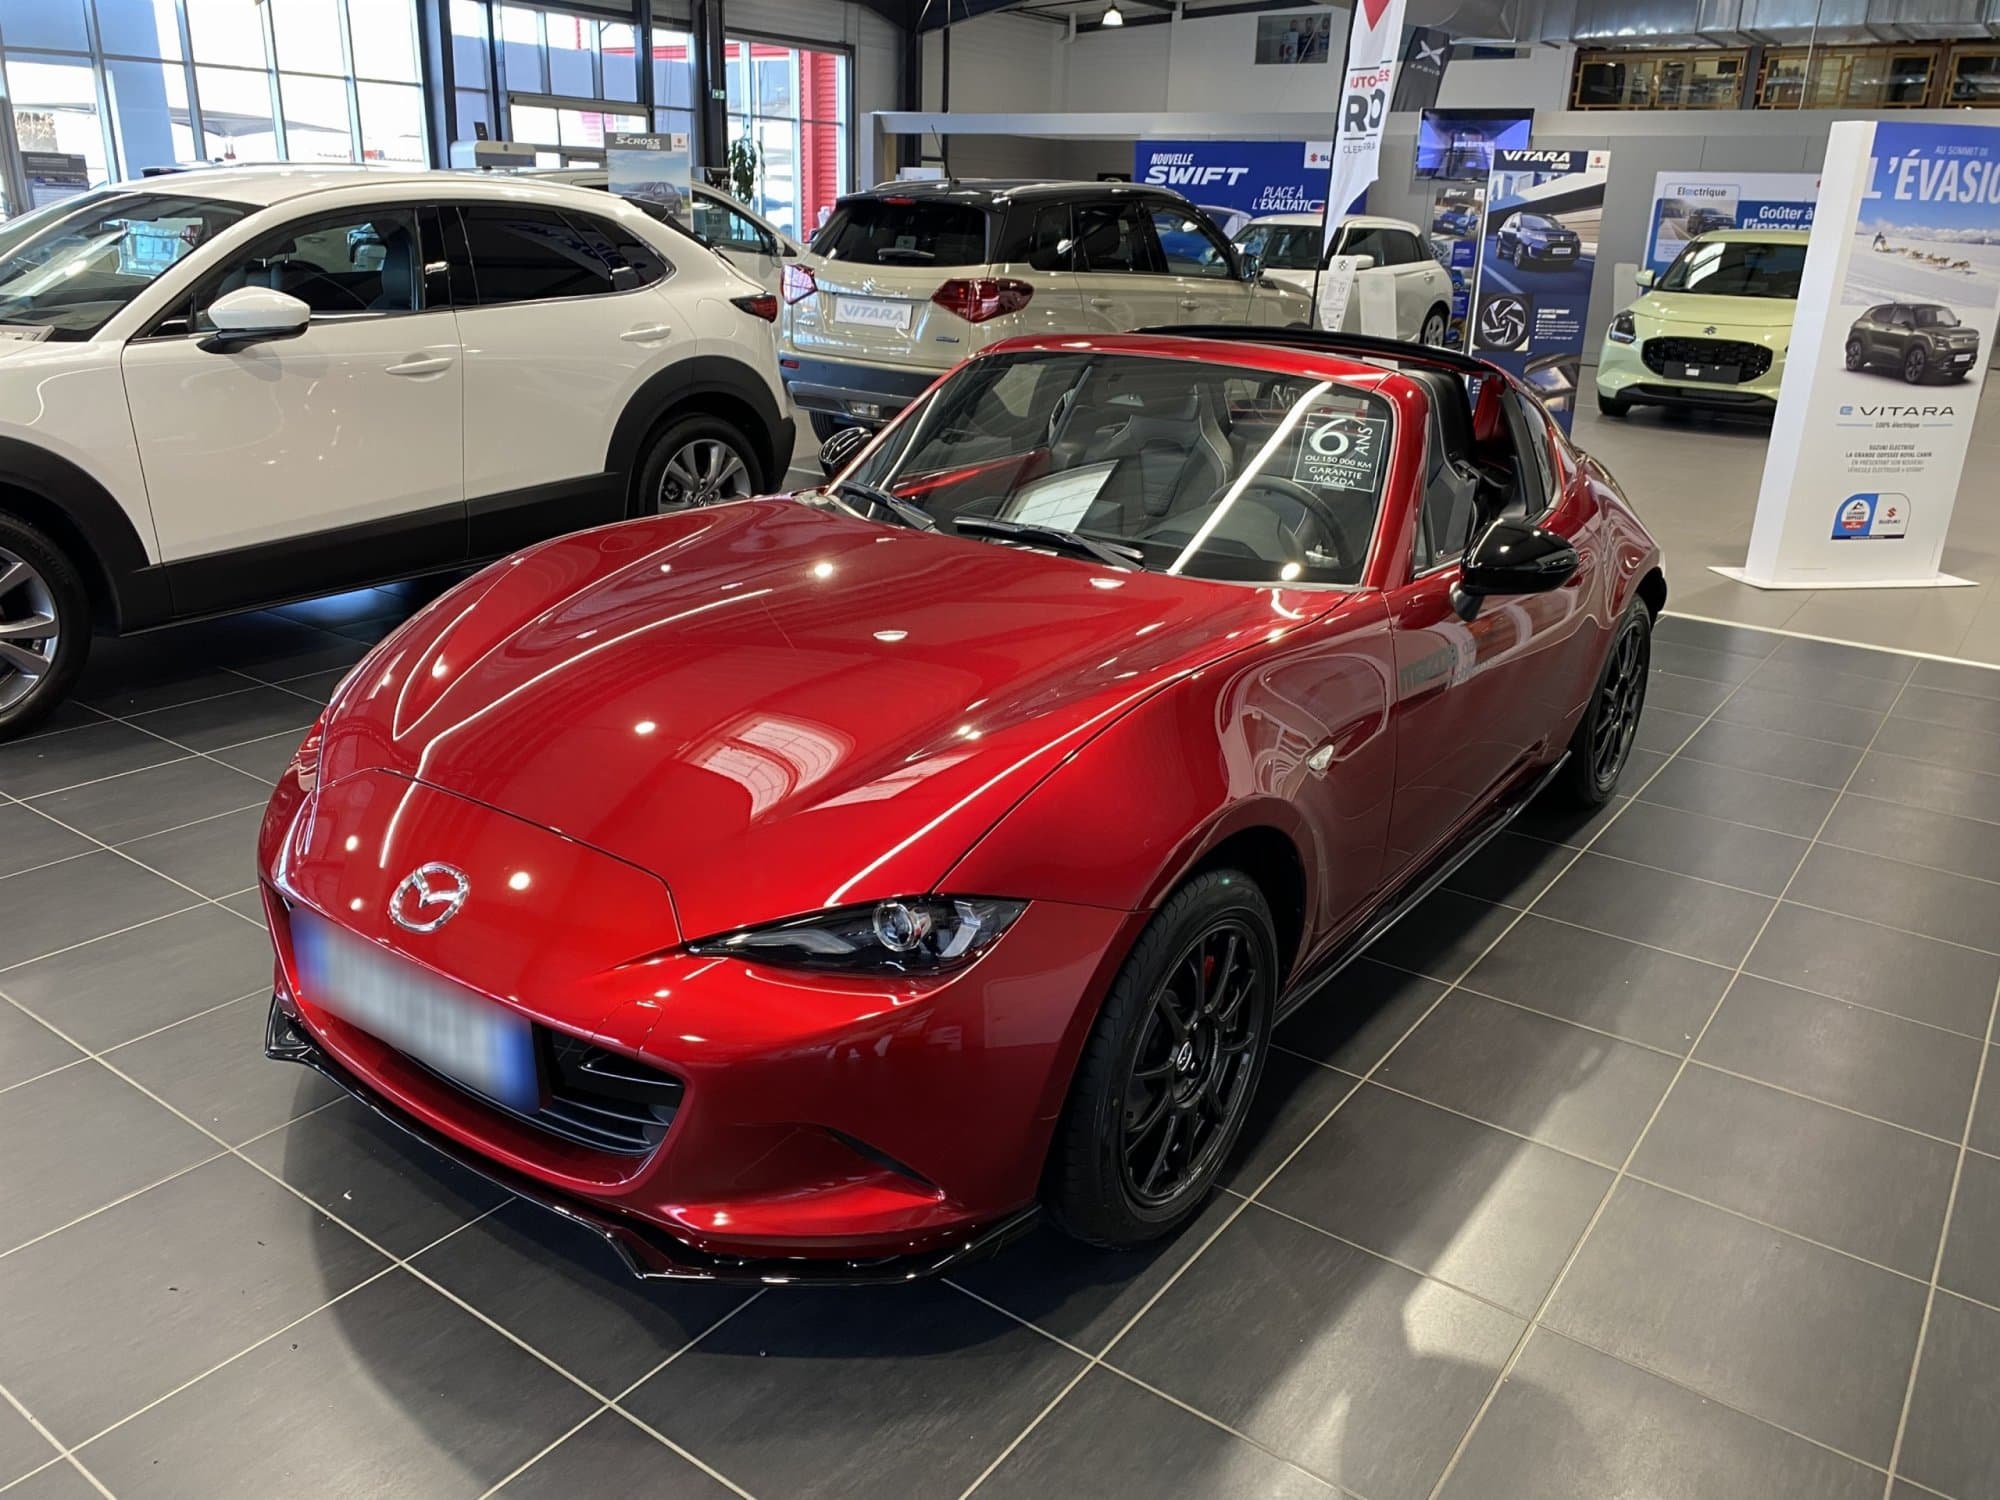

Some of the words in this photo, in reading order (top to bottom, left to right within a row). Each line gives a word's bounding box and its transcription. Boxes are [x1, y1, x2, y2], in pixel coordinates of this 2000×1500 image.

[1150, 153, 1194, 165] NOUVELLE
[1503, 150, 1570, 162] VITARA
[1144, 166, 1249, 186] SWIFT
[1263, 186, 1295, 199] PLACE
[1295, 184, 1304, 199] À
[1759, 205, 1803, 220] Goûter
[1804, 207, 1813, 221] à
[843, 303, 904, 322] VITARA
[1860, 406, 1954, 416] VITARA
[1309, 418, 1349, 455] 6
[1354, 426, 1373, 456] ANS
[1339, 457, 1355, 466] 000
[1357, 461, 1372, 469] KM
[1309, 466, 1363, 479] GARANTIE
[1313, 474, 1355, 486] MAZDA
